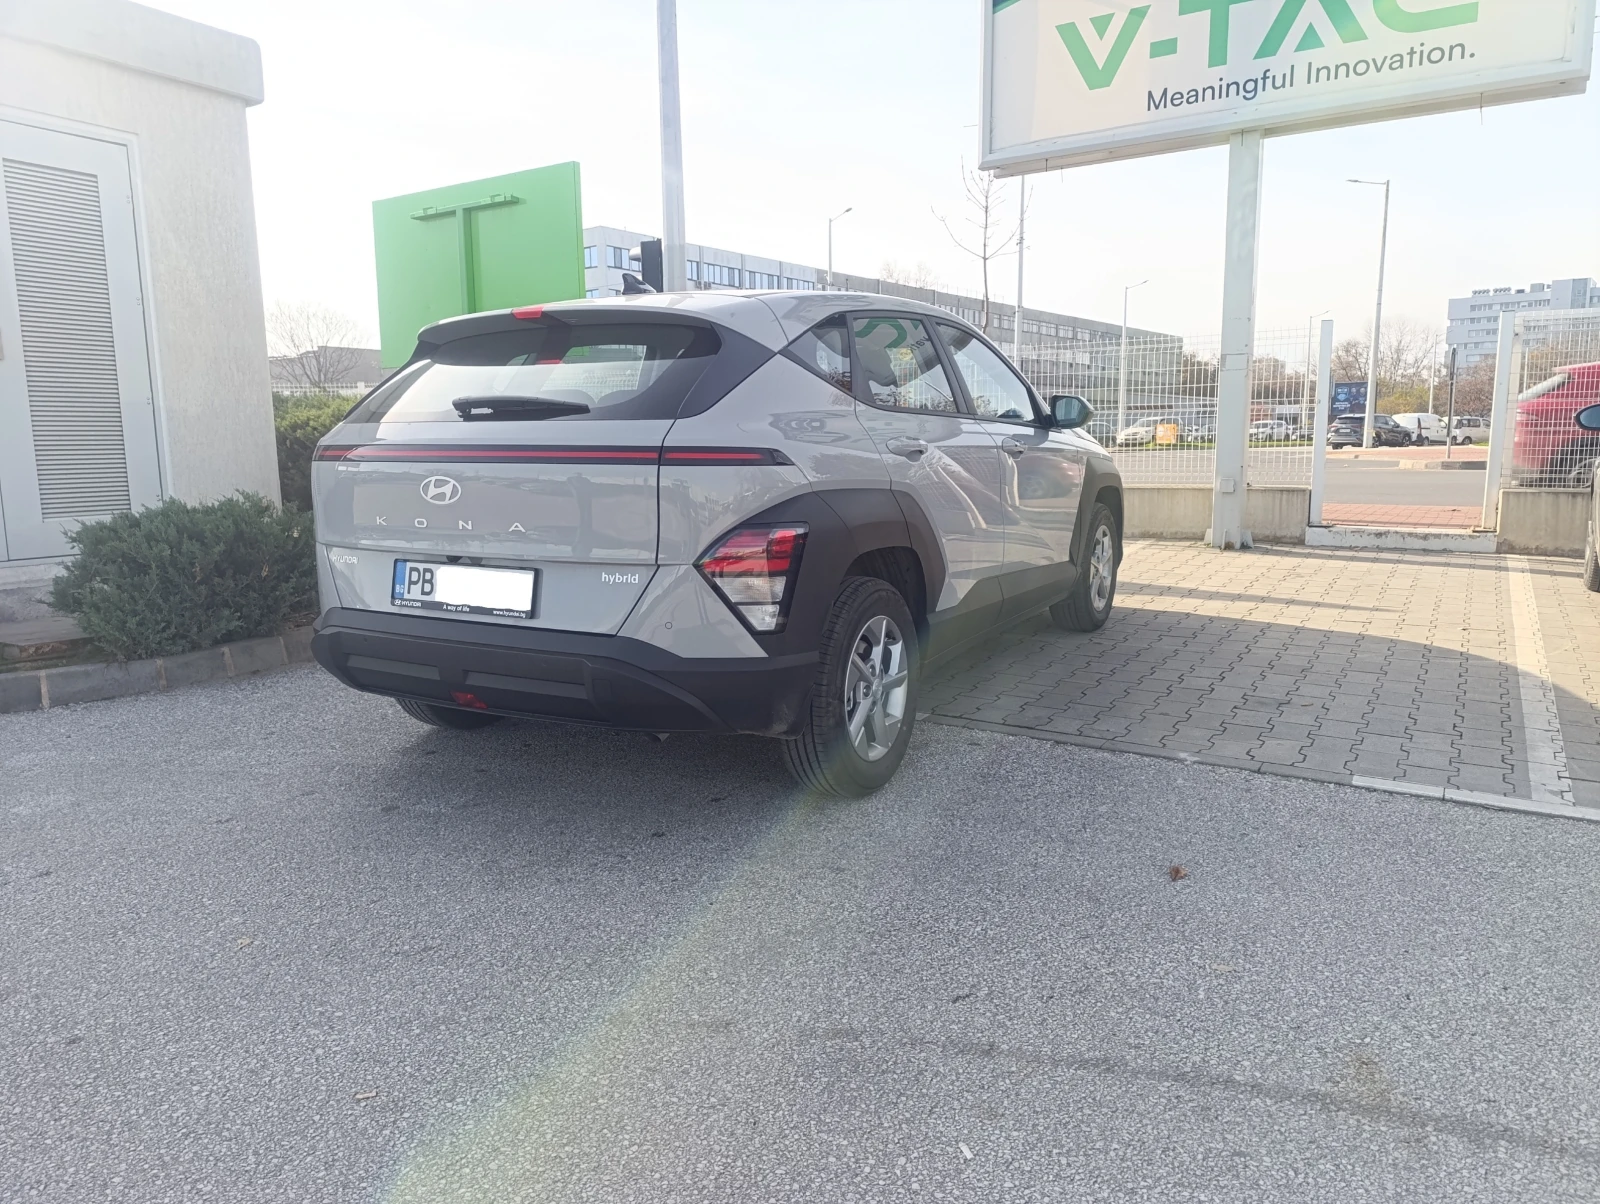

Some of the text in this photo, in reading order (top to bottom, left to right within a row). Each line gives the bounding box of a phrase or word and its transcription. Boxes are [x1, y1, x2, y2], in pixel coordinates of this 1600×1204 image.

[1146, 42, 1476, 111] Meaningful Innovation.
[376, 516, 526, 532] KONA
[407, 566, 434, 596] PB
[601, 571, 639, 584] hybrid
